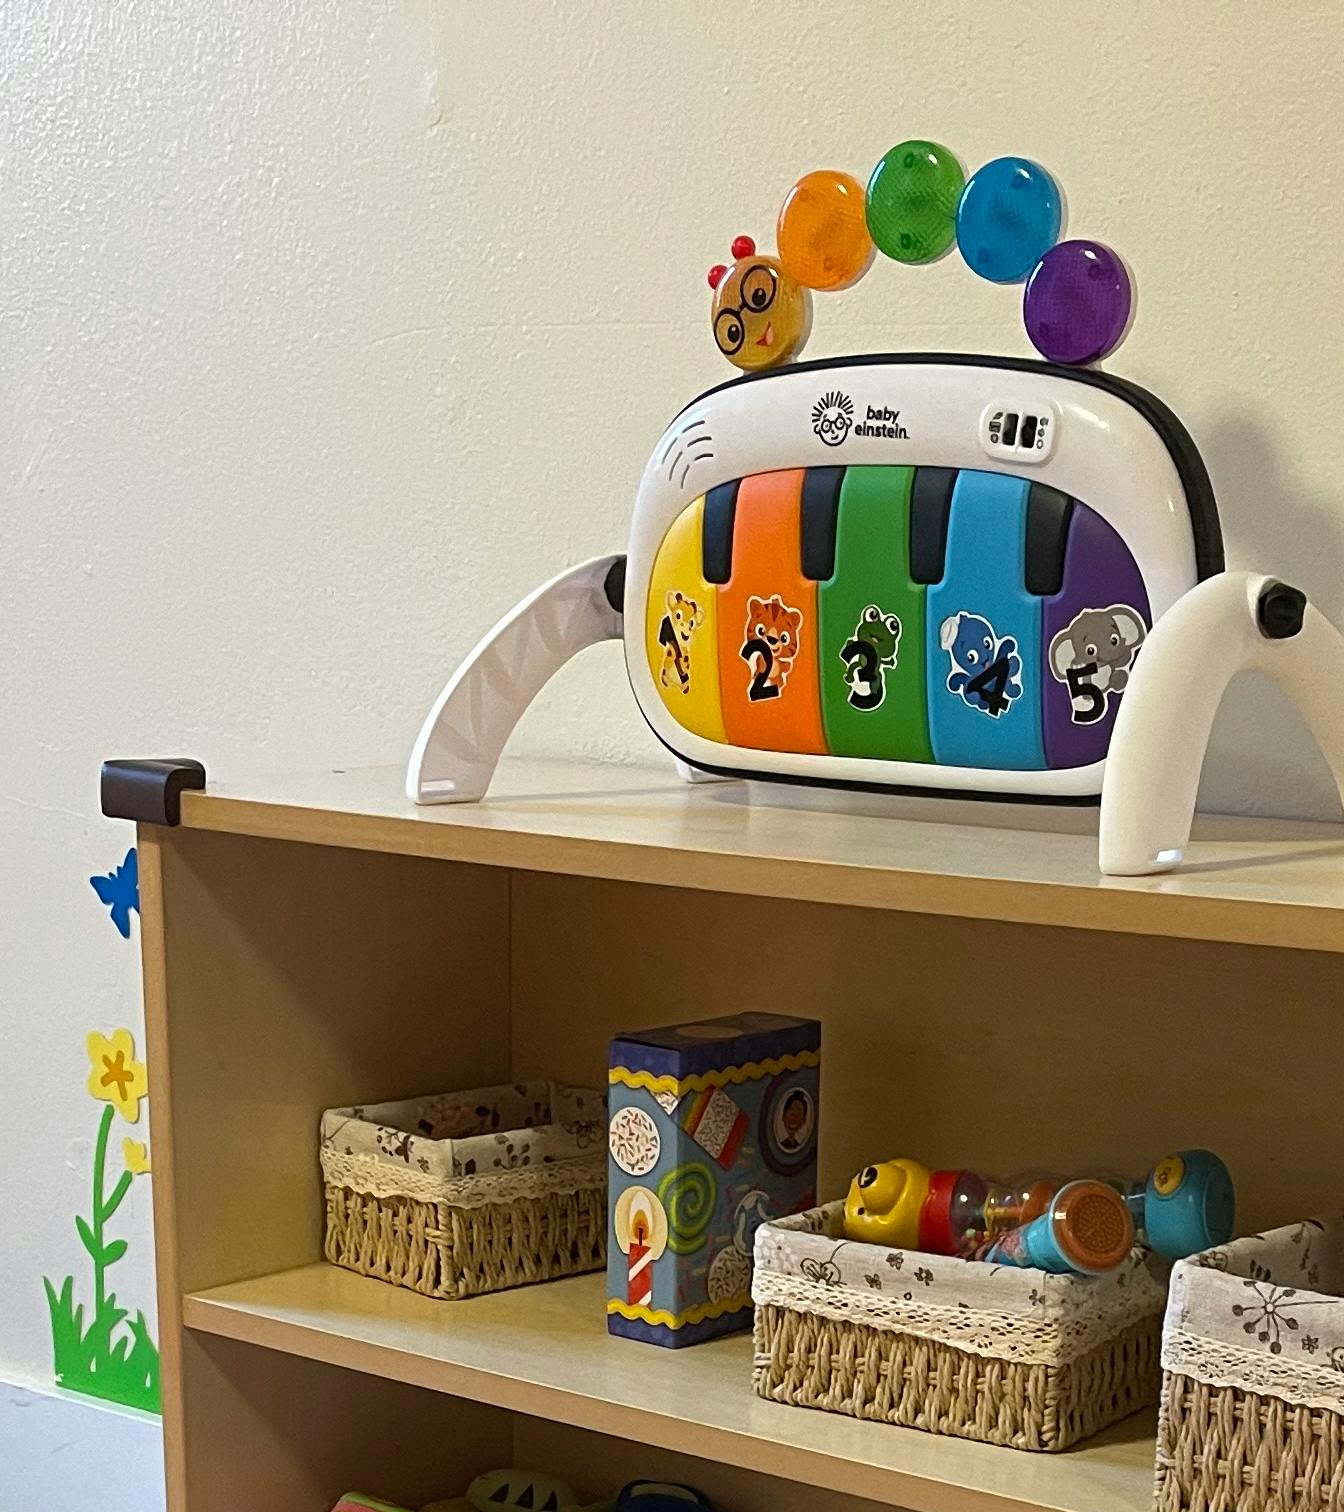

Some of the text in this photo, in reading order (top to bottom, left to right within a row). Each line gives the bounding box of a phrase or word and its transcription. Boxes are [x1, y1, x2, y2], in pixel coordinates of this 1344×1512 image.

[866, 405, 900, 424] baby
[741, 639, 780, 702] 2
[840, 640, 884, 710] 3
[966, 656, 1010, 717] 4
[1066, 661, 1106, 723] 5
